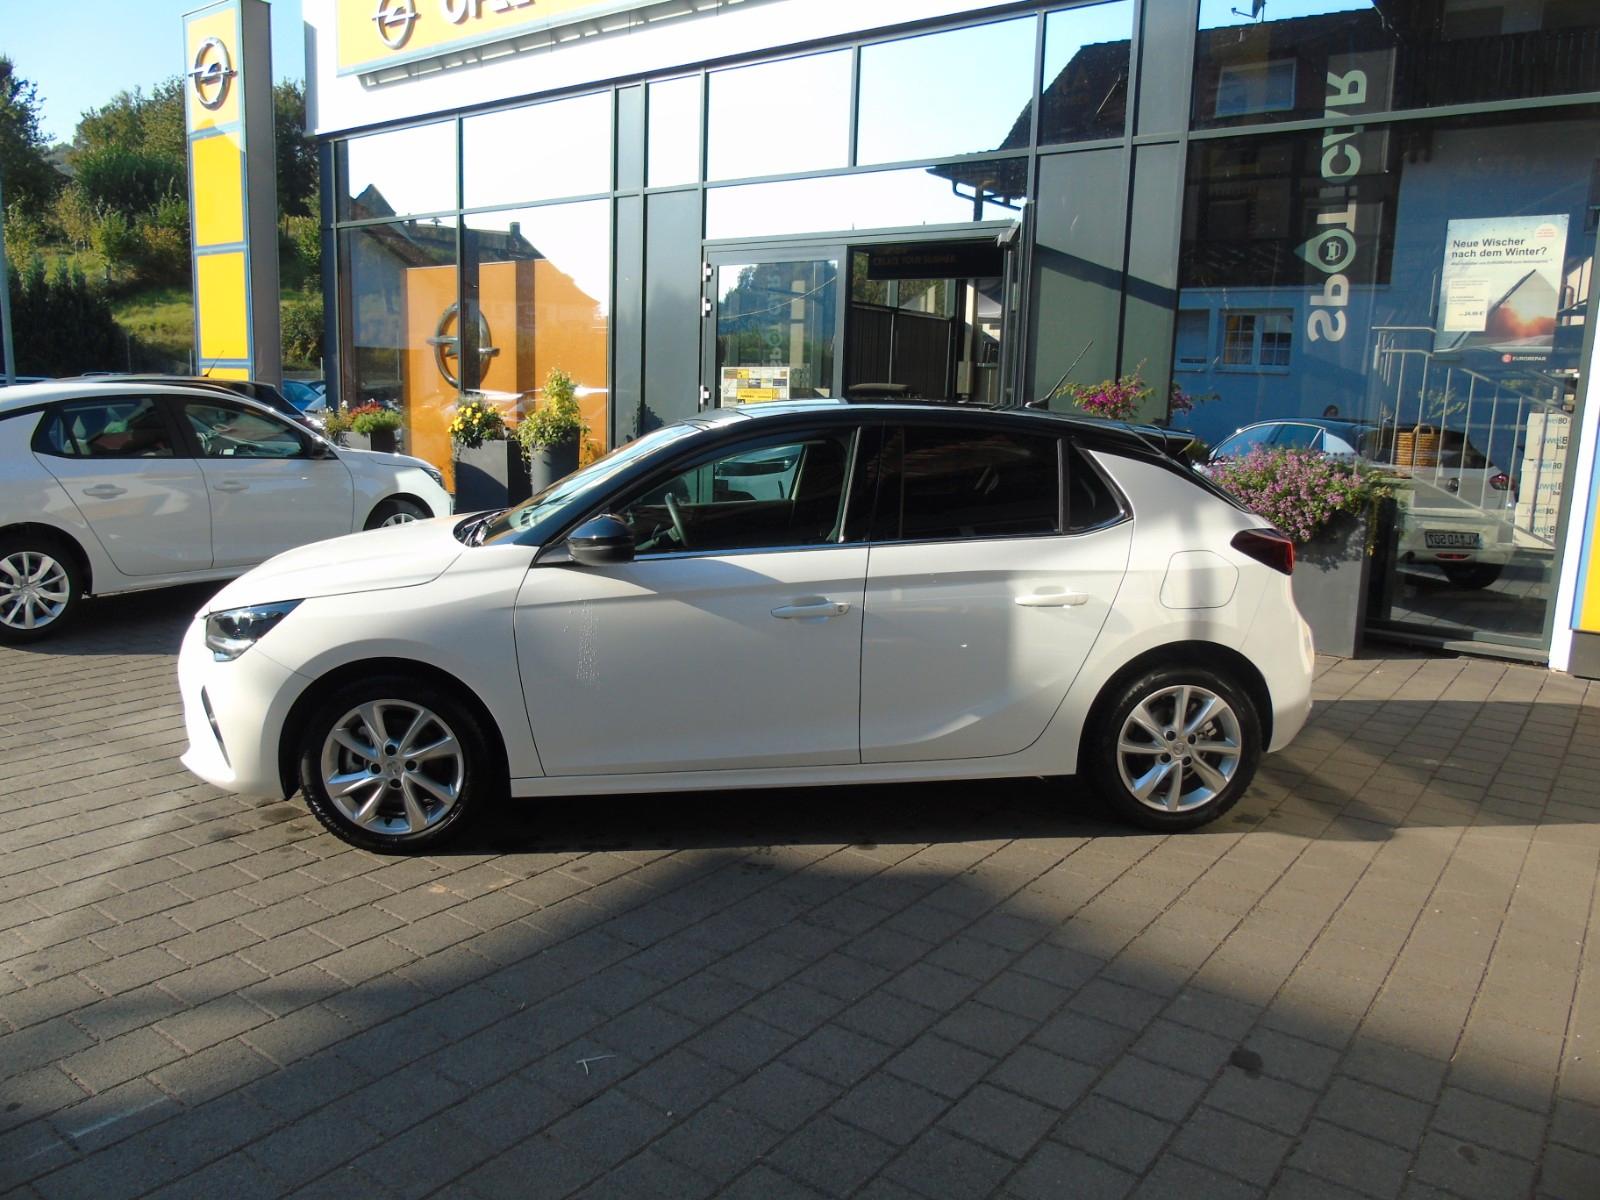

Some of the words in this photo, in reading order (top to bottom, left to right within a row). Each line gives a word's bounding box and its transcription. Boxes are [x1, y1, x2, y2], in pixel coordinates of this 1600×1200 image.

[1452, 240, 1479, 248] Neue
[1482, 237, 1526, 247] Wischer
[1451, 249, 1477, 258] nach
[1479, 247, 1502, 257] dem
[1505, 246, 1548, 256] Winter?
